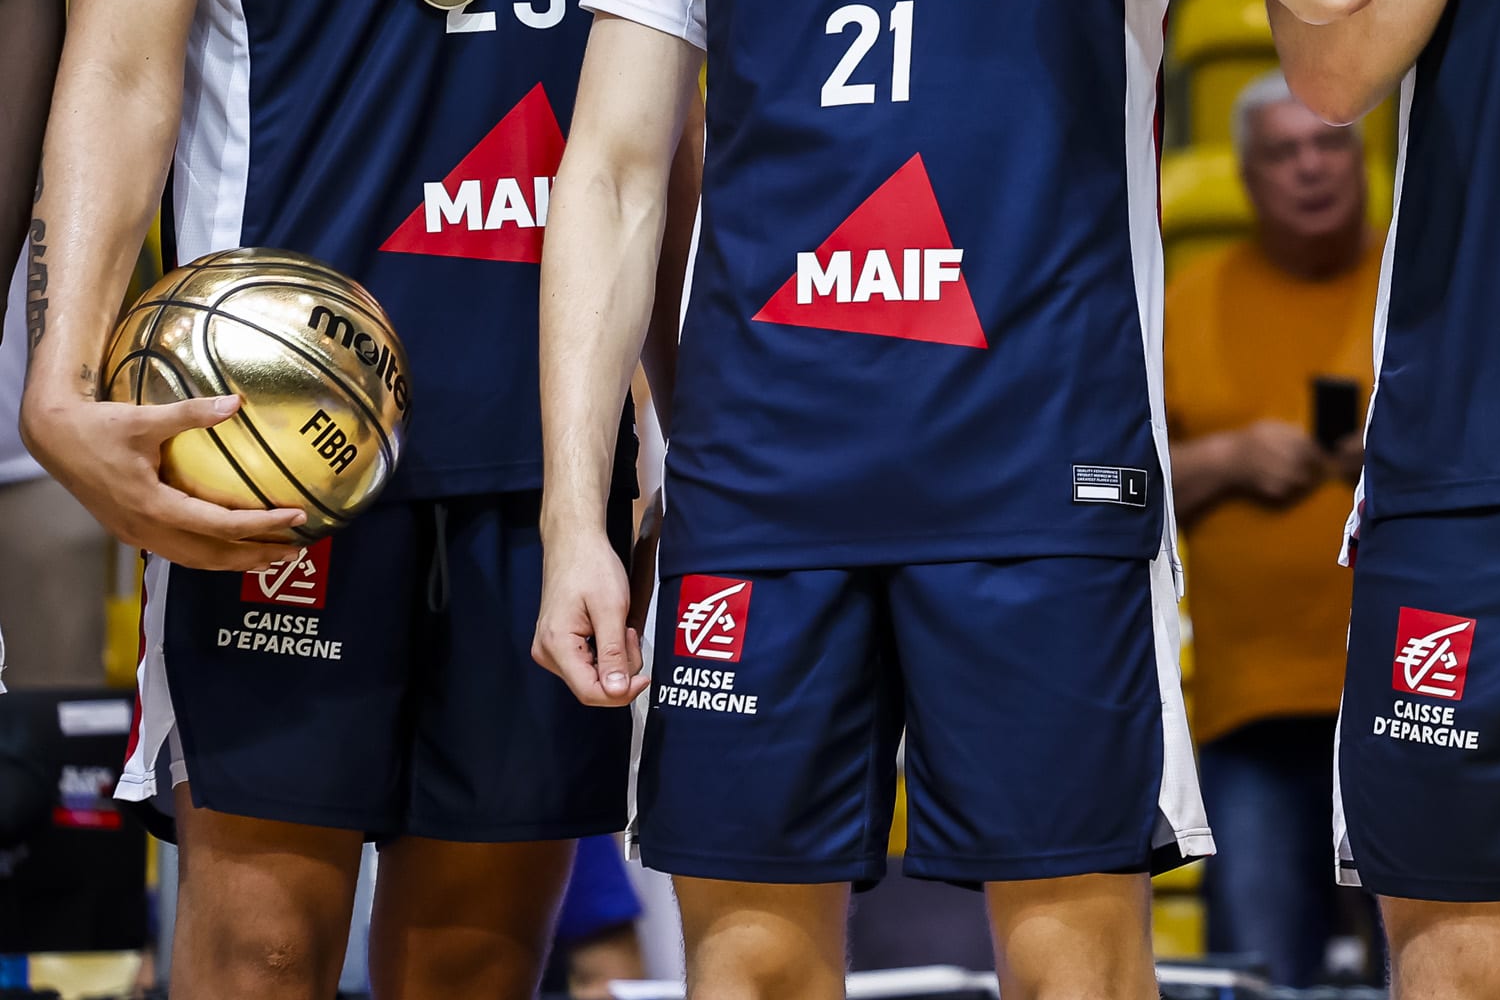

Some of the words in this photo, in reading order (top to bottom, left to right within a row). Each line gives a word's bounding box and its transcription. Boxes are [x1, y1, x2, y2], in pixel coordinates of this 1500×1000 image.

[820, 0, 915, 108] 21
[423, 176, 556, 233] MAI
[796, 248, 964, 305] MAIF
[299, 408, 358, 475] FIBA
[1129, 478, 1138, 495] L
[243, 611, 319, 636] CAISSE
[217, 628, 343, 660] D'EPARGNE
[673, 666, 736, 691] CAISSE
[658, 685, 758, 715] D'EPARGNE
[1394, 700, 1455, 726] CAISSE
[1373, 716, 1480, 750] D'EPARGNE
